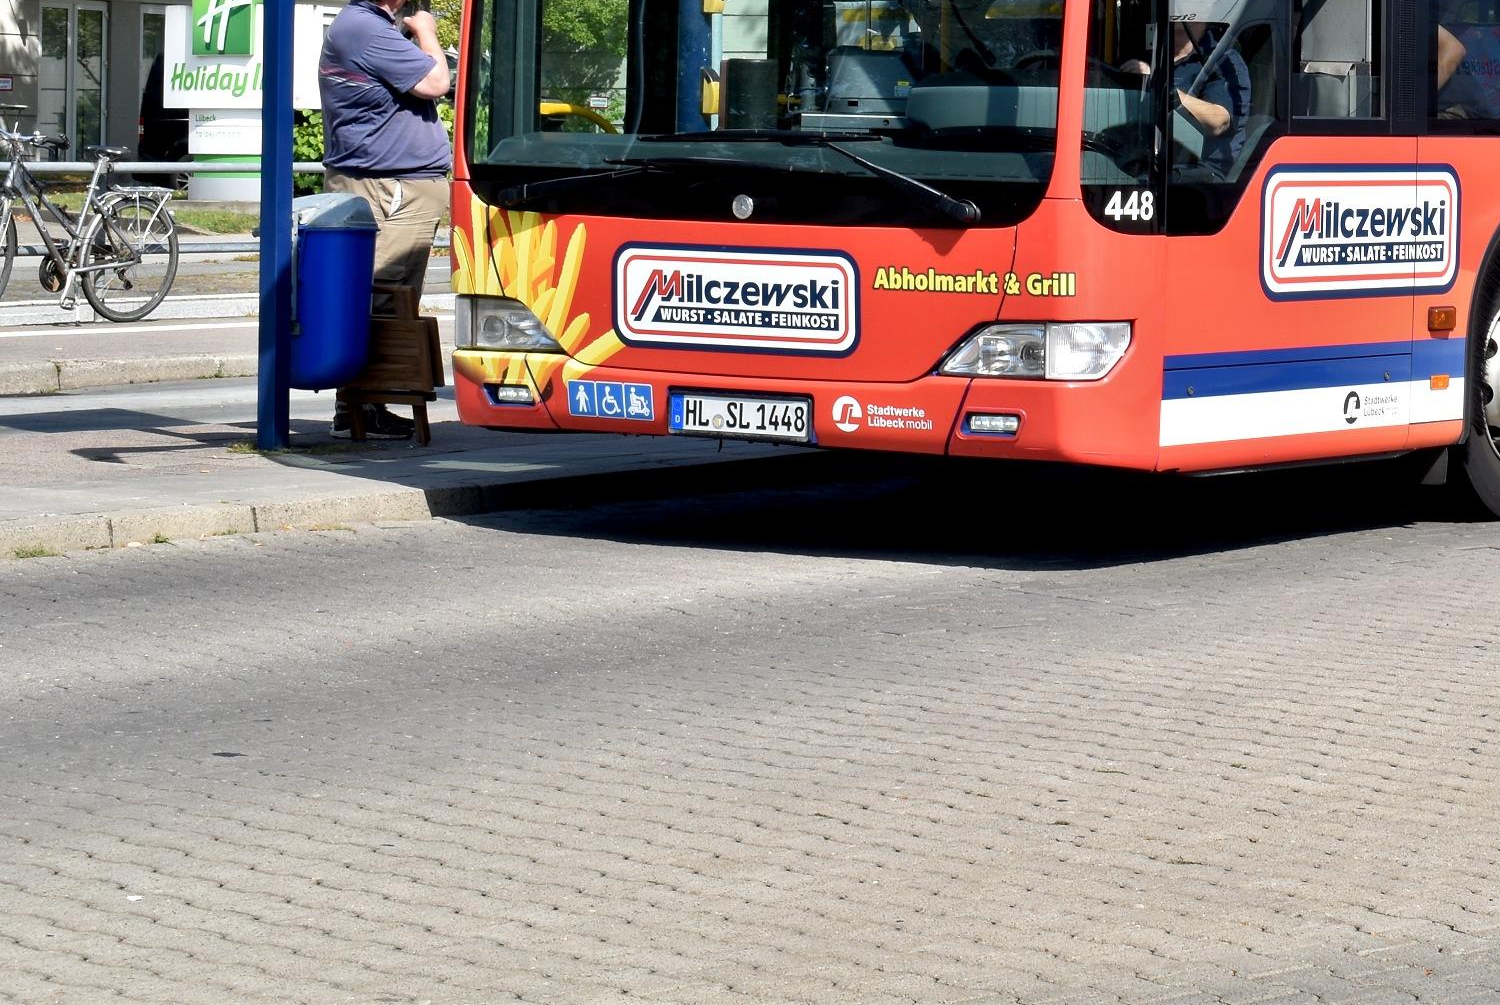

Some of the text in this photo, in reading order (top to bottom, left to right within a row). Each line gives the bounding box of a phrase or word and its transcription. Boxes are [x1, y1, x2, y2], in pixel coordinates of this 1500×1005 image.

[171, 62, 248, 98] Holiday
[1104, 190, 1154, 221] 448
[1276, 198, 1446, 267] Milczewski
[1302, 243, 1443, 264] WURST SALATE FEINKOST
[630, 269, 840, 321] Milczewski
[873, 267, 1076, 296] Abholmarkt & Grill
[660, 307, 837, 330] WURST SALATE FEINKOST
[685, 399, 709, 427] HL
[726, 401, 750, 430] SL
[755, 403, 805, 433] 1448
[867, 404, 925, 419] Stadtwerke
[867, 415, 933, 430] Lübeck mobil
